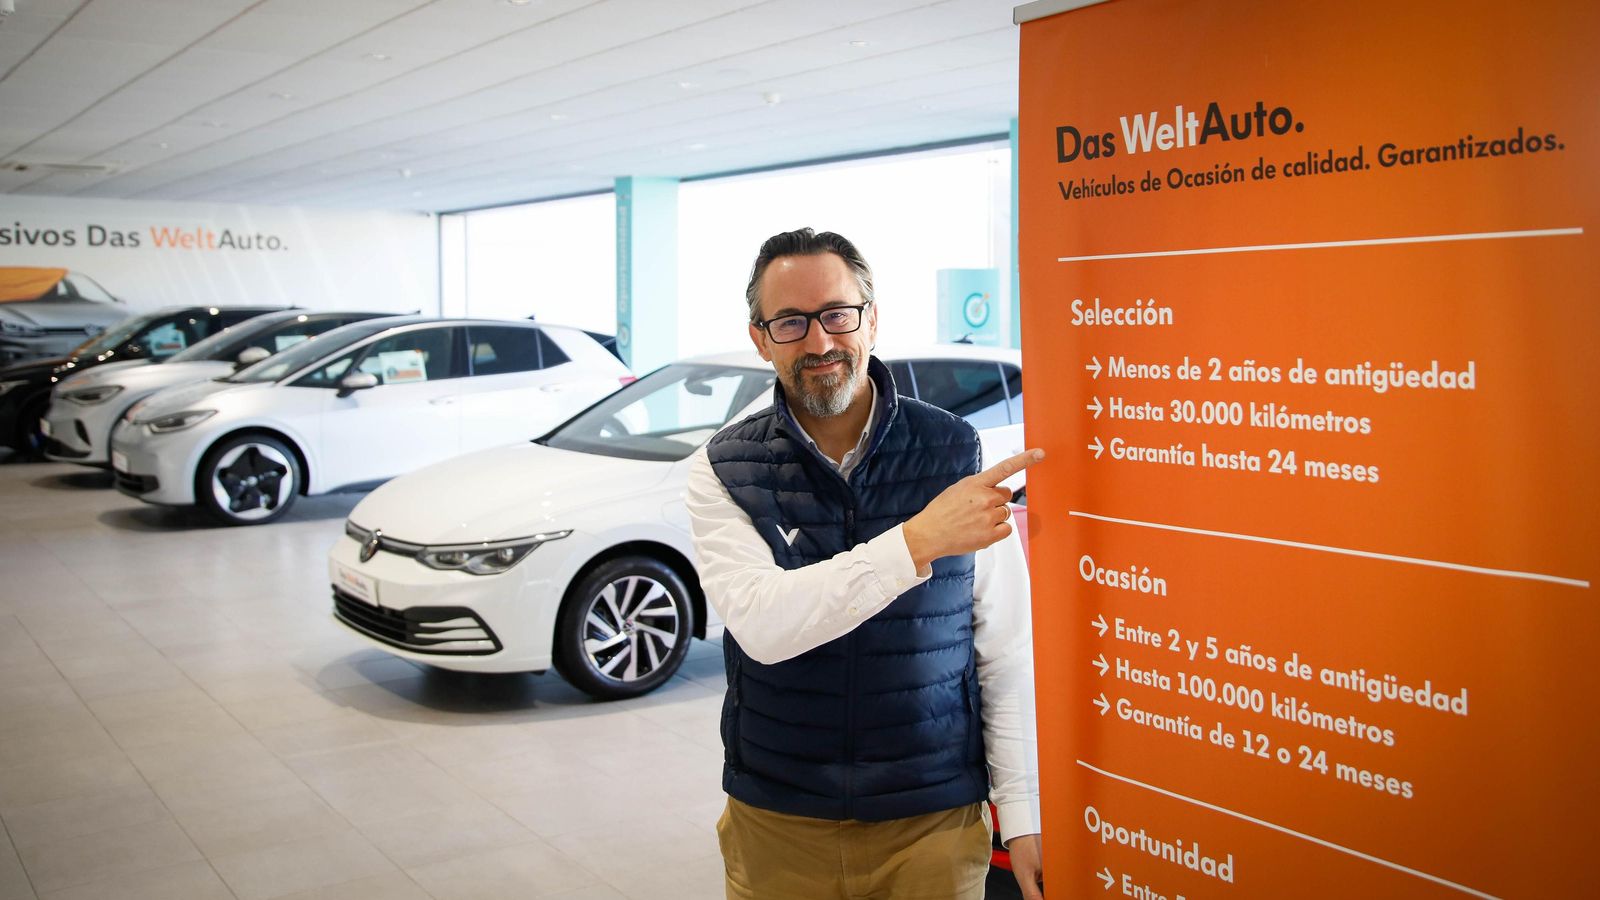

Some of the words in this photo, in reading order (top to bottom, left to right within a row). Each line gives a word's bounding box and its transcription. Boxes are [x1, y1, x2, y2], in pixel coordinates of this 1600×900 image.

[1056, 125, 1116, 164] Das
[1119, 101, 1305, 155] WeltAuto.
[1058, 174, 1135, 200] Vehículos
[1140, 170, 1162, 193] de
[1166, 163, 1245, 190] Ocasión
[1251, 157, 1276, 181] de
[1283, 145, 1371, 178] calidad.
[1377, 127, 1566, 168] Garantizados.
[87, 225, 141, 248] Das
[150, 226, 289, 252] WeltAuto.
[1071, 298, 1174, 326] Selección
[1108, 356, 1171, 381] Menos
[1176, 356, 1202, 381] de
[1207, 357, 1222, 381] 2
[1228, 359, 1282, 383] años
[1288, 357, 1318, 385] de
[1324, 360, 1476, 394] antigüedad
[1109, 396, 1164, 422] Hasta
[1170, 399, 1244, 426] 30.000
[1249, 401, 1372, 435] kilómetros
[1109, 437, 1196, 466] Garantía
[1201, 443, 1261, 472] hasta
[1267, 448, 1298, 475] 24
[1304, 460, 1380, 483] meses
[1079, 554, 1167, 597] Ocasión
[1115, 617, 1162, 648] Entre
[1167, 628, 1181, 652] 2
[1185, 639, 1199, 661] y
[1205, 636, 1219, 660] 5
[1225, 644, 1277, 673] años
[1284, 652, 1313, 681] de
[1320, 668, 1468, 716] antigüedad
[1116, 657, 1171, 691] Hasta
[1177, 671, 1265, 713] 100.000
[1271, 692, 1395, 747] kilómetros
[1116, 698, 1203, 741] Garantía
[1209, 722, 1235, 749] de
[1242, 729, 1270, 759] 12
[1276, 747, 1291, 764] o
[1298, 745, 1329, 775] 24
[1336, 763, 1413, 799] meses
[1084, 806, 1234, 883] Oportunidad
